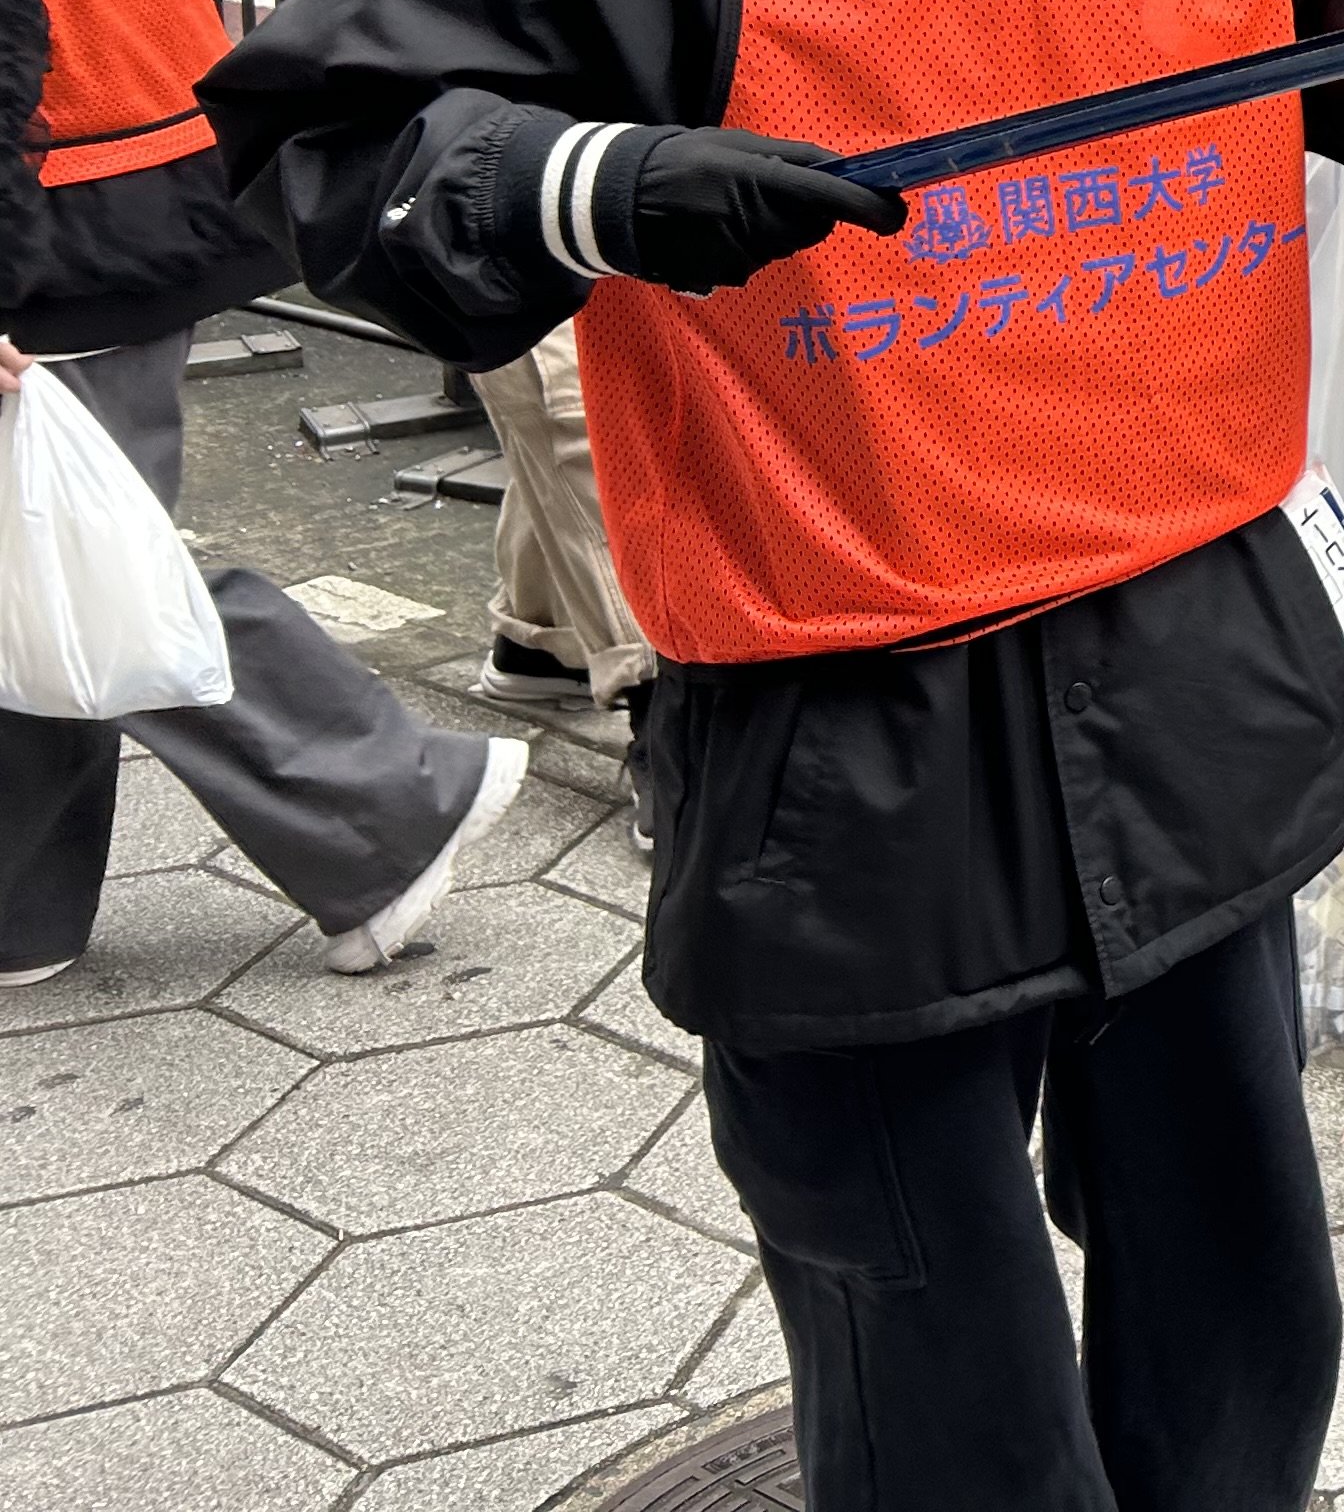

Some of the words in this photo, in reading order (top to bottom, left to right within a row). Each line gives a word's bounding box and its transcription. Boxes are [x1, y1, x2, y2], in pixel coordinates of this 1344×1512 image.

[998, 143, 1226, 245] 関西大学
[779, 219, 1307, 364] ボランティアセンター
